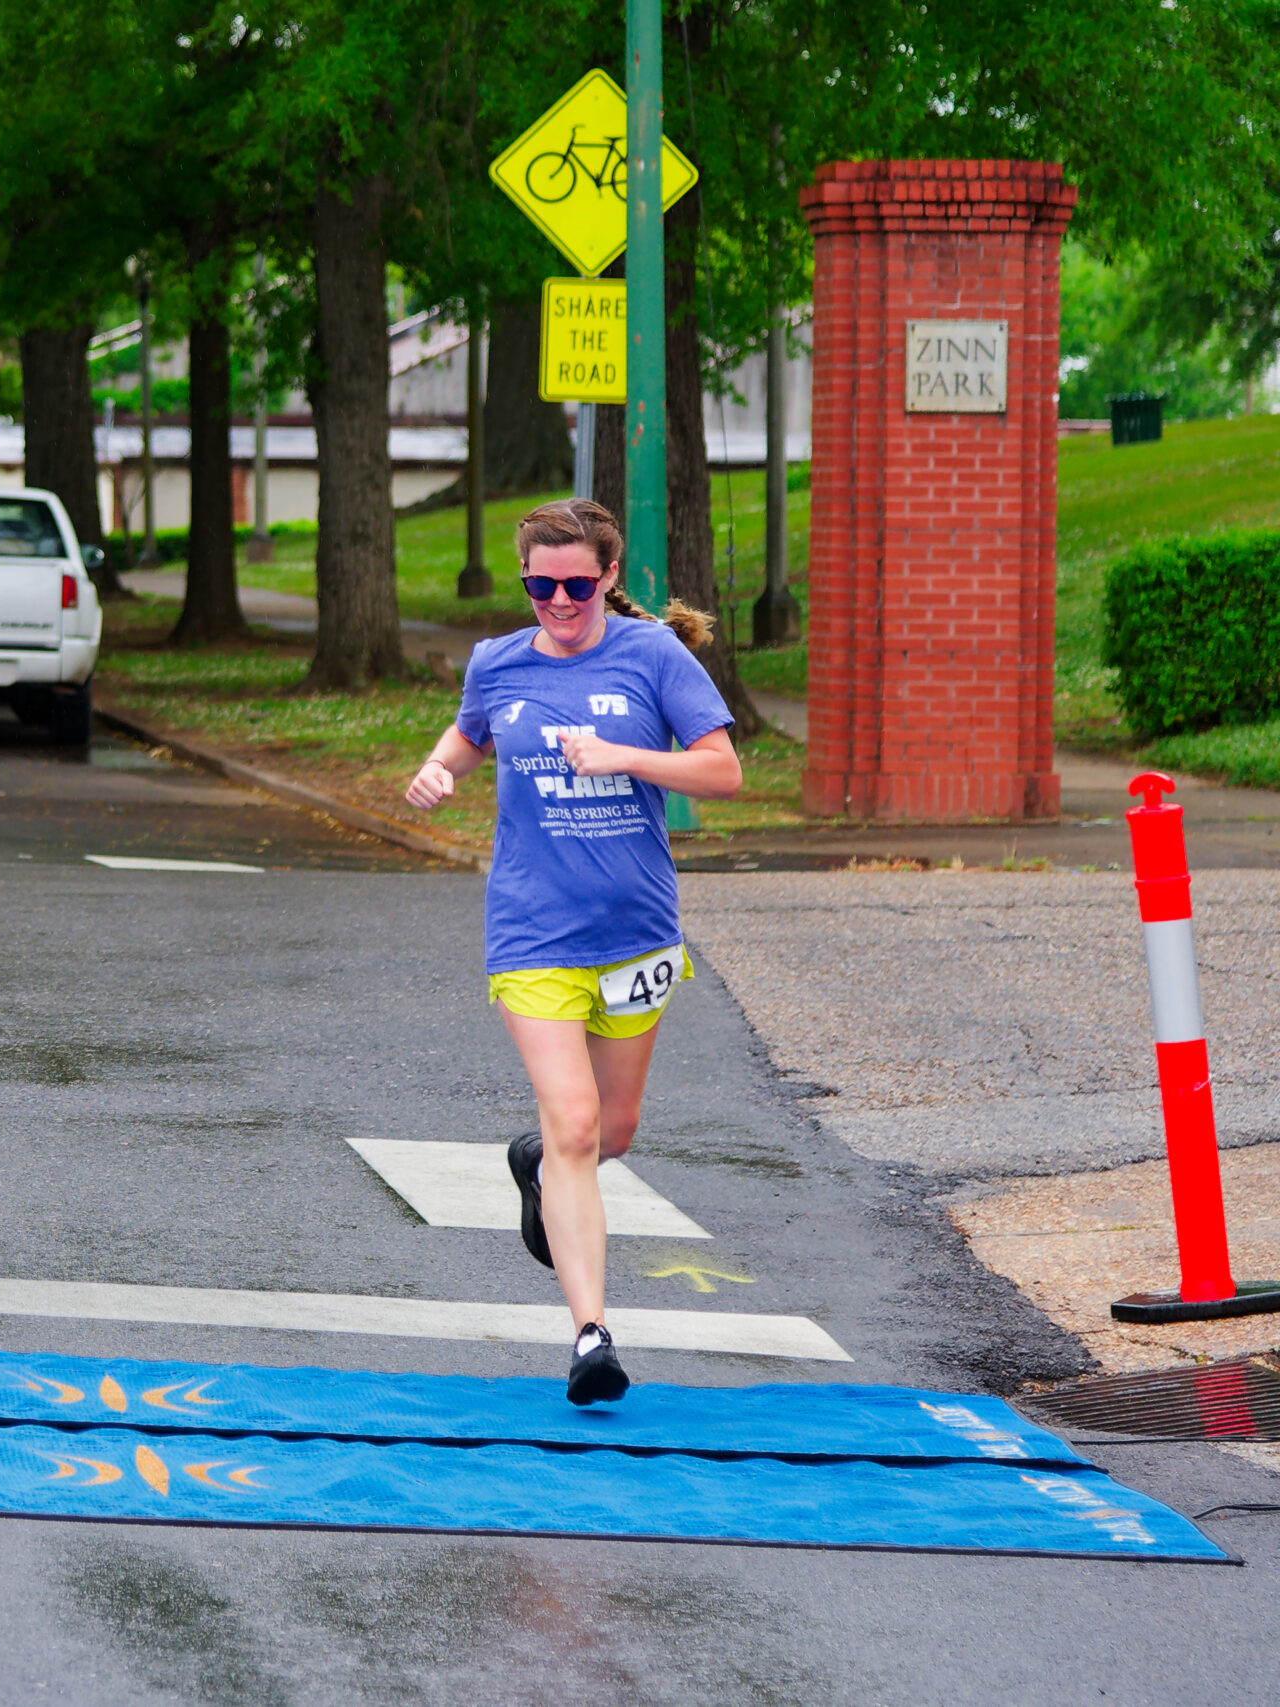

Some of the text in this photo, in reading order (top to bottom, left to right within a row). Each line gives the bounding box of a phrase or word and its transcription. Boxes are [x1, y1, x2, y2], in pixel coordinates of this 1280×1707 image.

[553, 295, 627, 320] SHARE
[569, 328, 609, 352] THE
[917, 338, 997, 362] ZINN
[558, 362, 616, 386] ROAD
[913, 371, 994, 397] PARK
[589, 694, 629, 716] 175
[512, 753, 569, 775] Spring
[534, 775, 634, 799] PLACE
[573, 805, 622, 820] SPRING
[623, 804, 642, 816] 5K
[578, 820, 610, 829] Anniston
[585, 830, 594, 840] of
[622, 825, 645, 834] County
[629, 960, 673, 1005] 49
